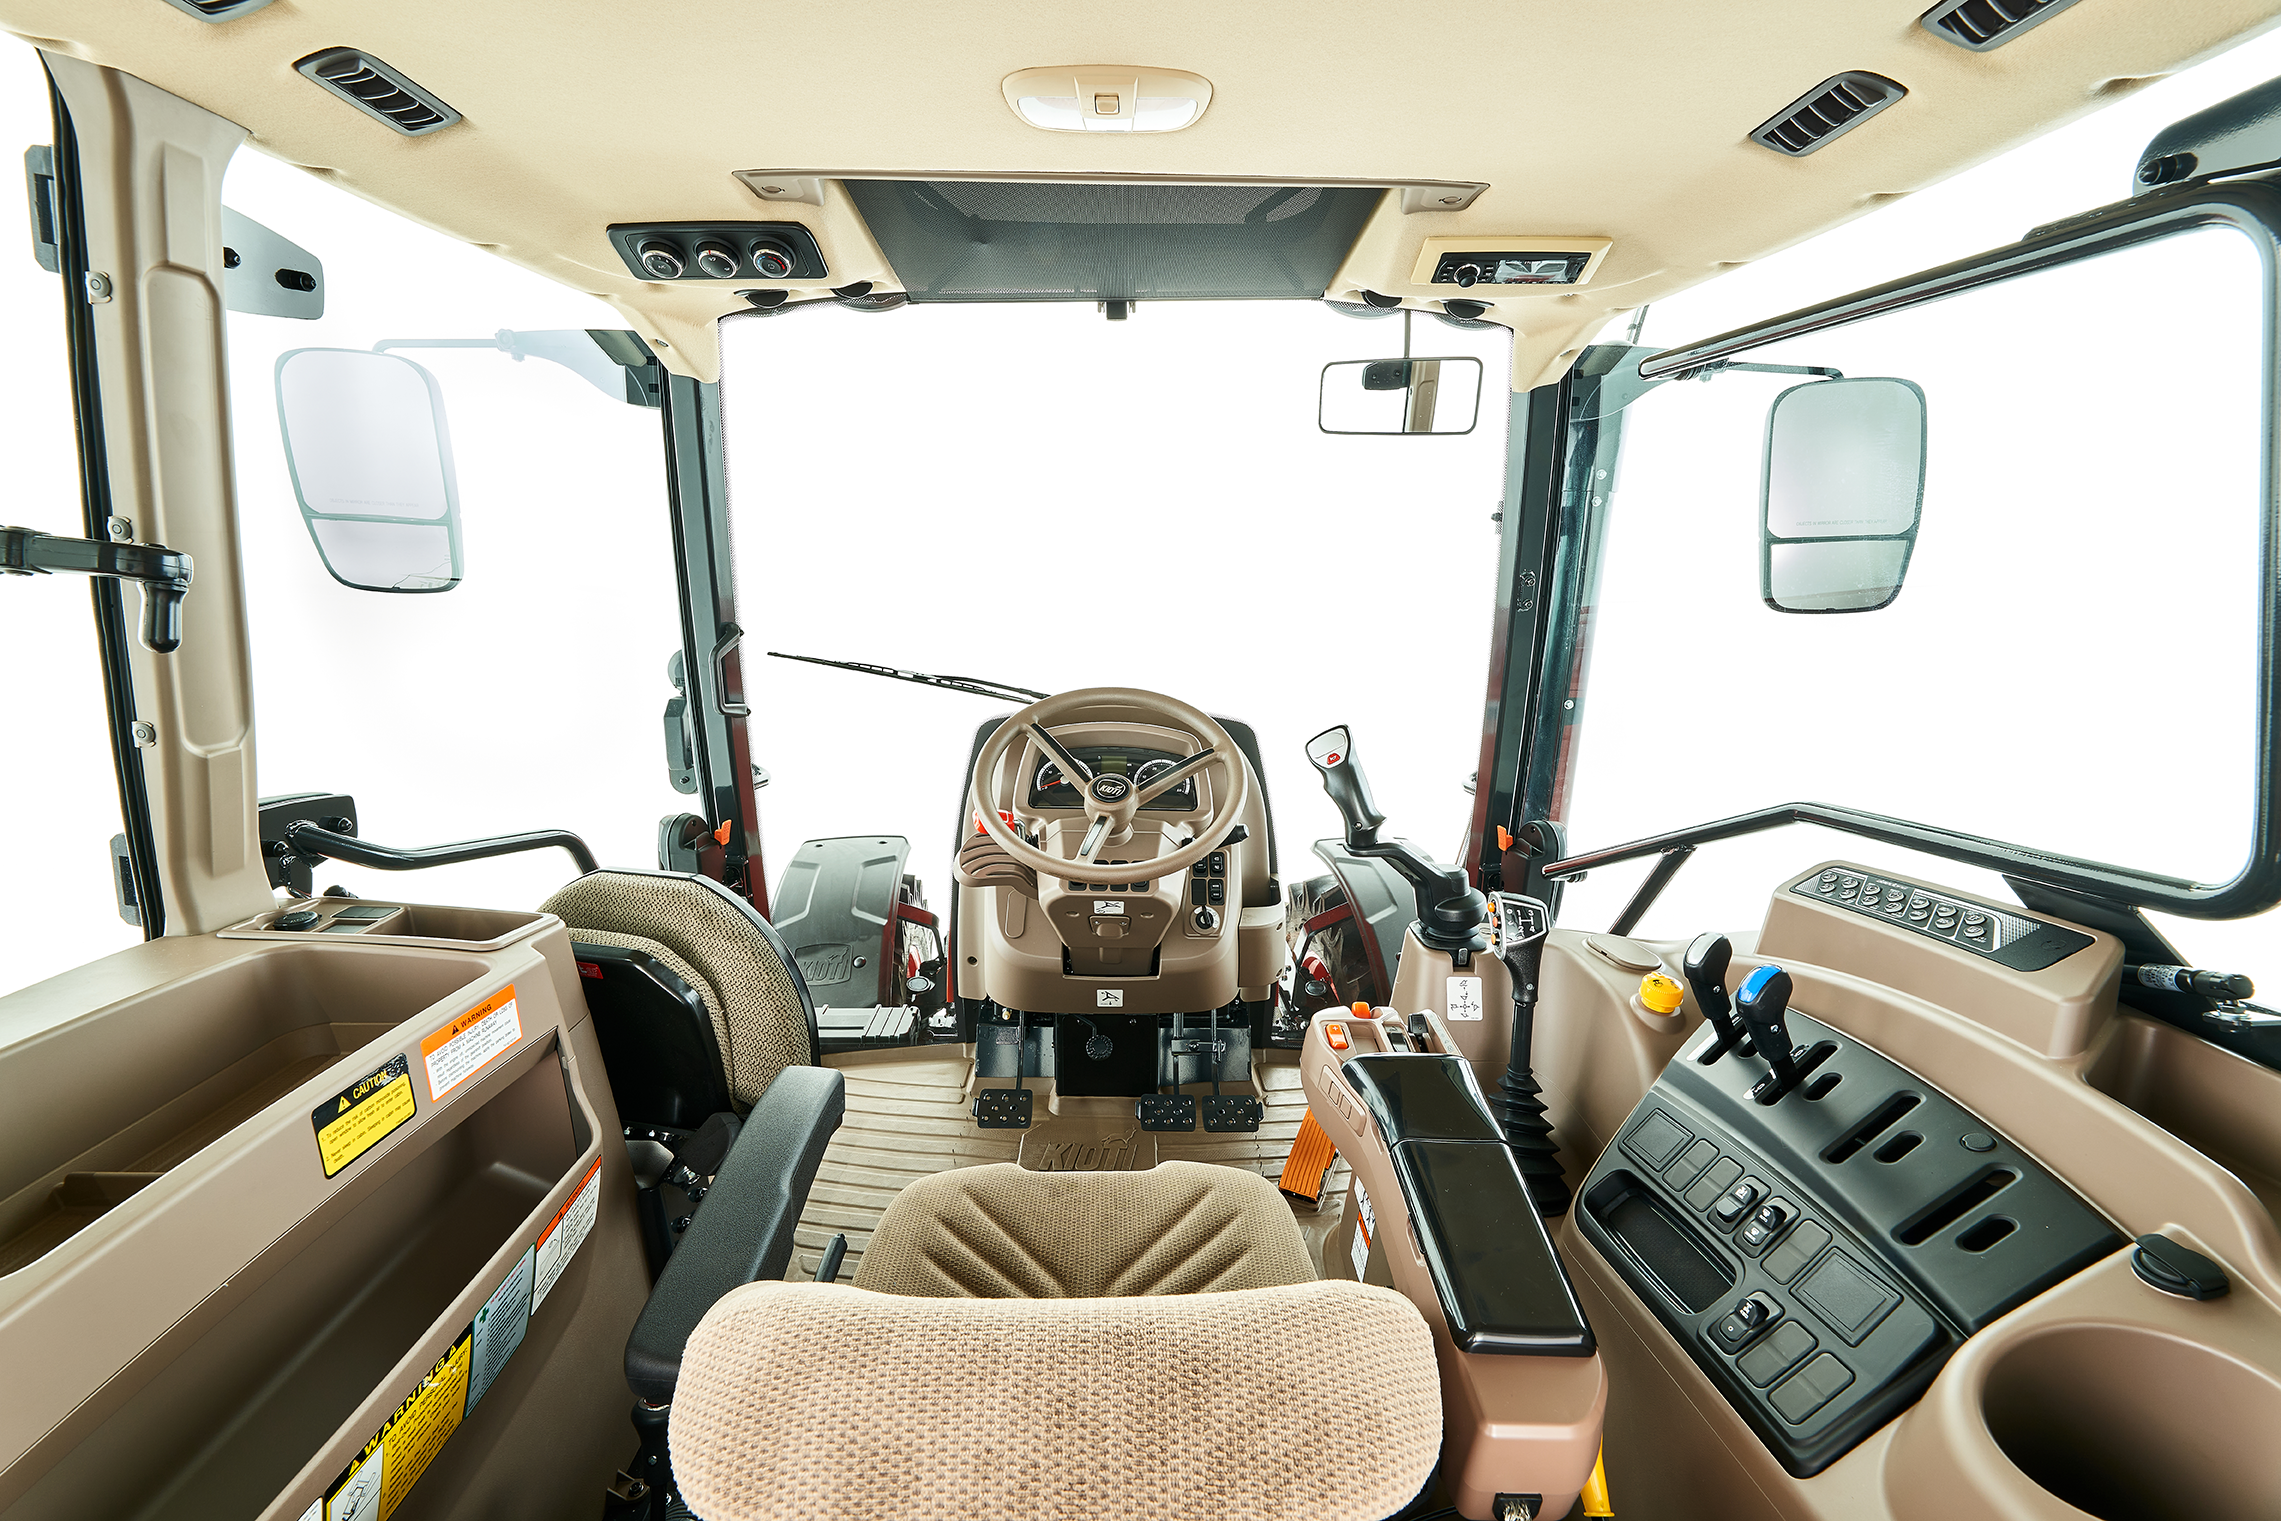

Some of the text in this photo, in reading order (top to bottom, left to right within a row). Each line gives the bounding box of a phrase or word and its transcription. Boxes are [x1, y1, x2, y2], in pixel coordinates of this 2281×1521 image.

[1099, 783, 1122, 796] KIOTI
[460, 1003, 492, 1028] WARNING
[353, 1069, 387, 1099] CAUTION
[1038, 1142, 1138, 1171] KIOTI
[363, 1357, 445, 1456] WARNING
